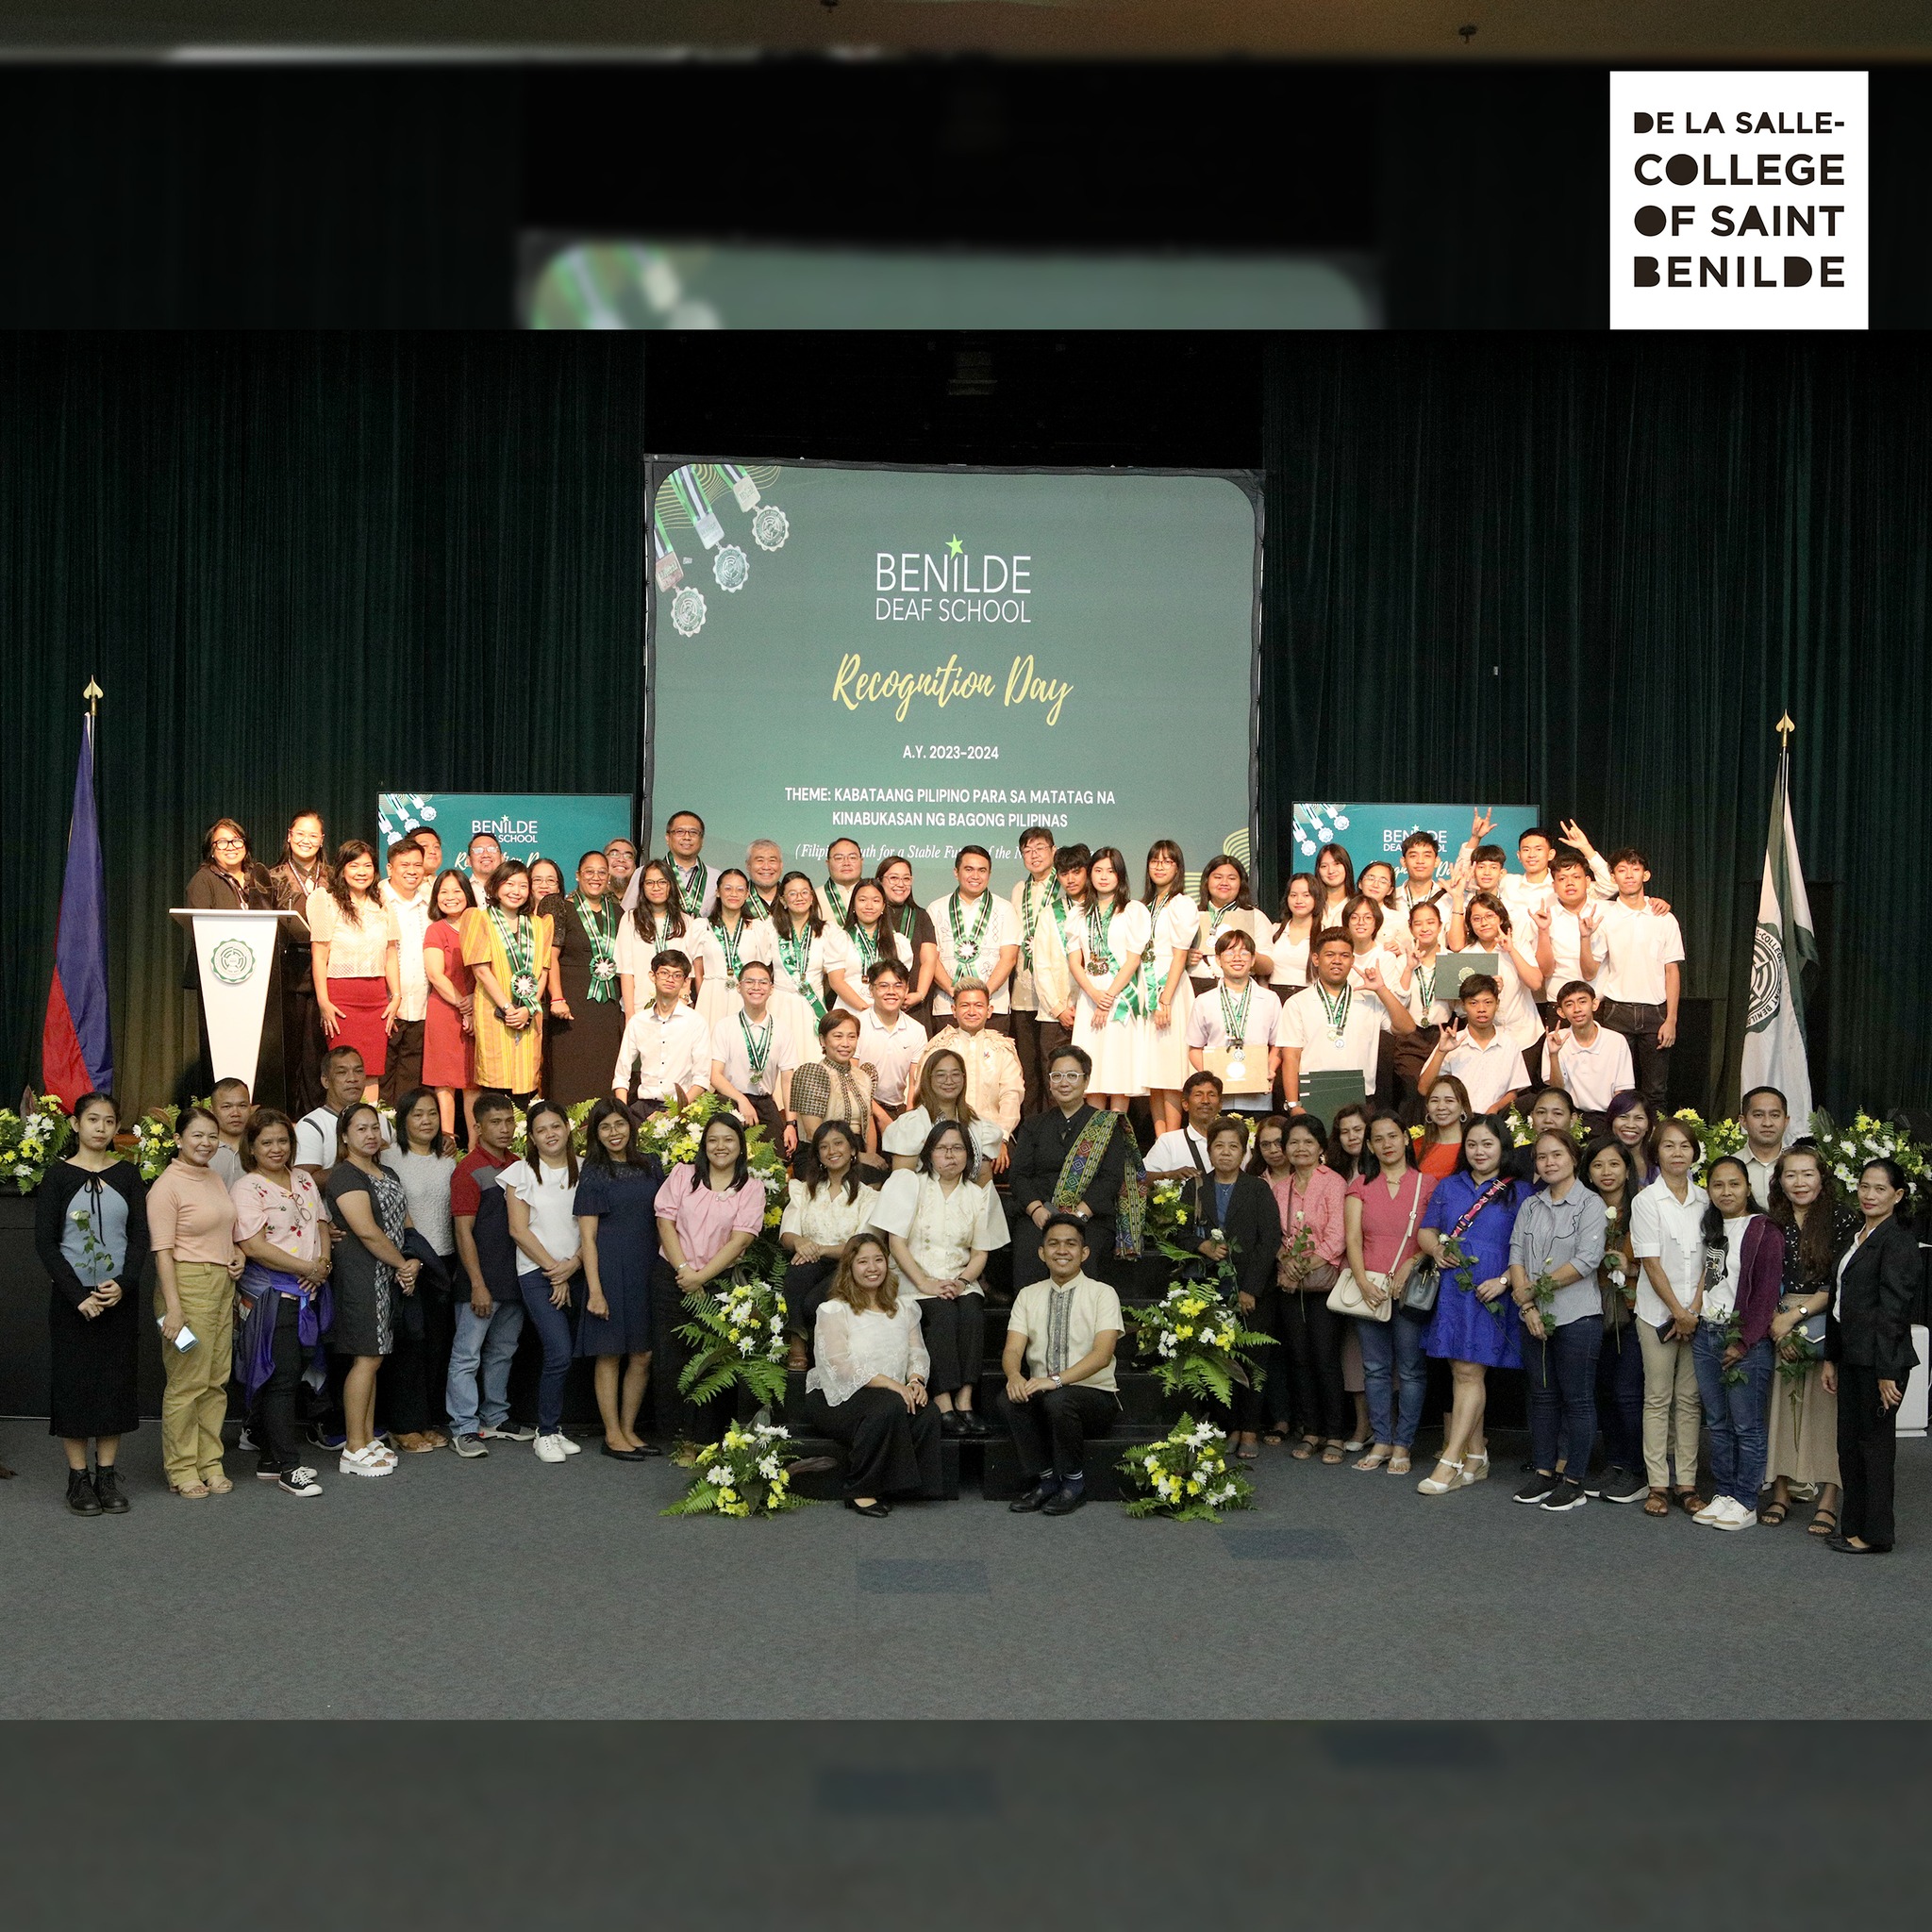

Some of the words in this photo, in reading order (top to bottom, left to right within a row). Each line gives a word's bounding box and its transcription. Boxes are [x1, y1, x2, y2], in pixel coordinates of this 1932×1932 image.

[876, 552, 1031, 593] BENILDE
[875, 597, 932, 622] DEAF
[939, 598, 1031, 623] SCHOOL
[832, 653, 996, 723] Recognition
[1004, 654, 1074, 726] Day
[902, 745, 926, 759] A.Y.
[929, 745, 1000, 759] 2023-2024
[785, 787, 831, 802] THEME:
[834, 788, 914, 803] KABATAANG
[917, 789, 970, 803] PILIPINO
[973, 789, 1008, 803] PARA
[1009, 790, 1026, 804] SA
[1029, 790, 1093, 805] MATATAG
[1096, 791, 1116, 805] NA
[472, 820, 539, 834] BENILDE
[832, 811, 923, 826] KINABUKASAN
[925, 812, 945, 826] NG
[948, 813, 1005, 827] BAGONG
[1008, 813, 1068, 827] PILIPINAS
[498, 834, 539, 843] SCHOOL
[1383, 829, 1447, 843] BENDE
[877, 845, 895, 860] for
[897, 849, 905, 858] a
[907, 844, 941, 858] Stable
[994, 846, 1011, 859] the
[1383, 842, 1402, 852] DEA
